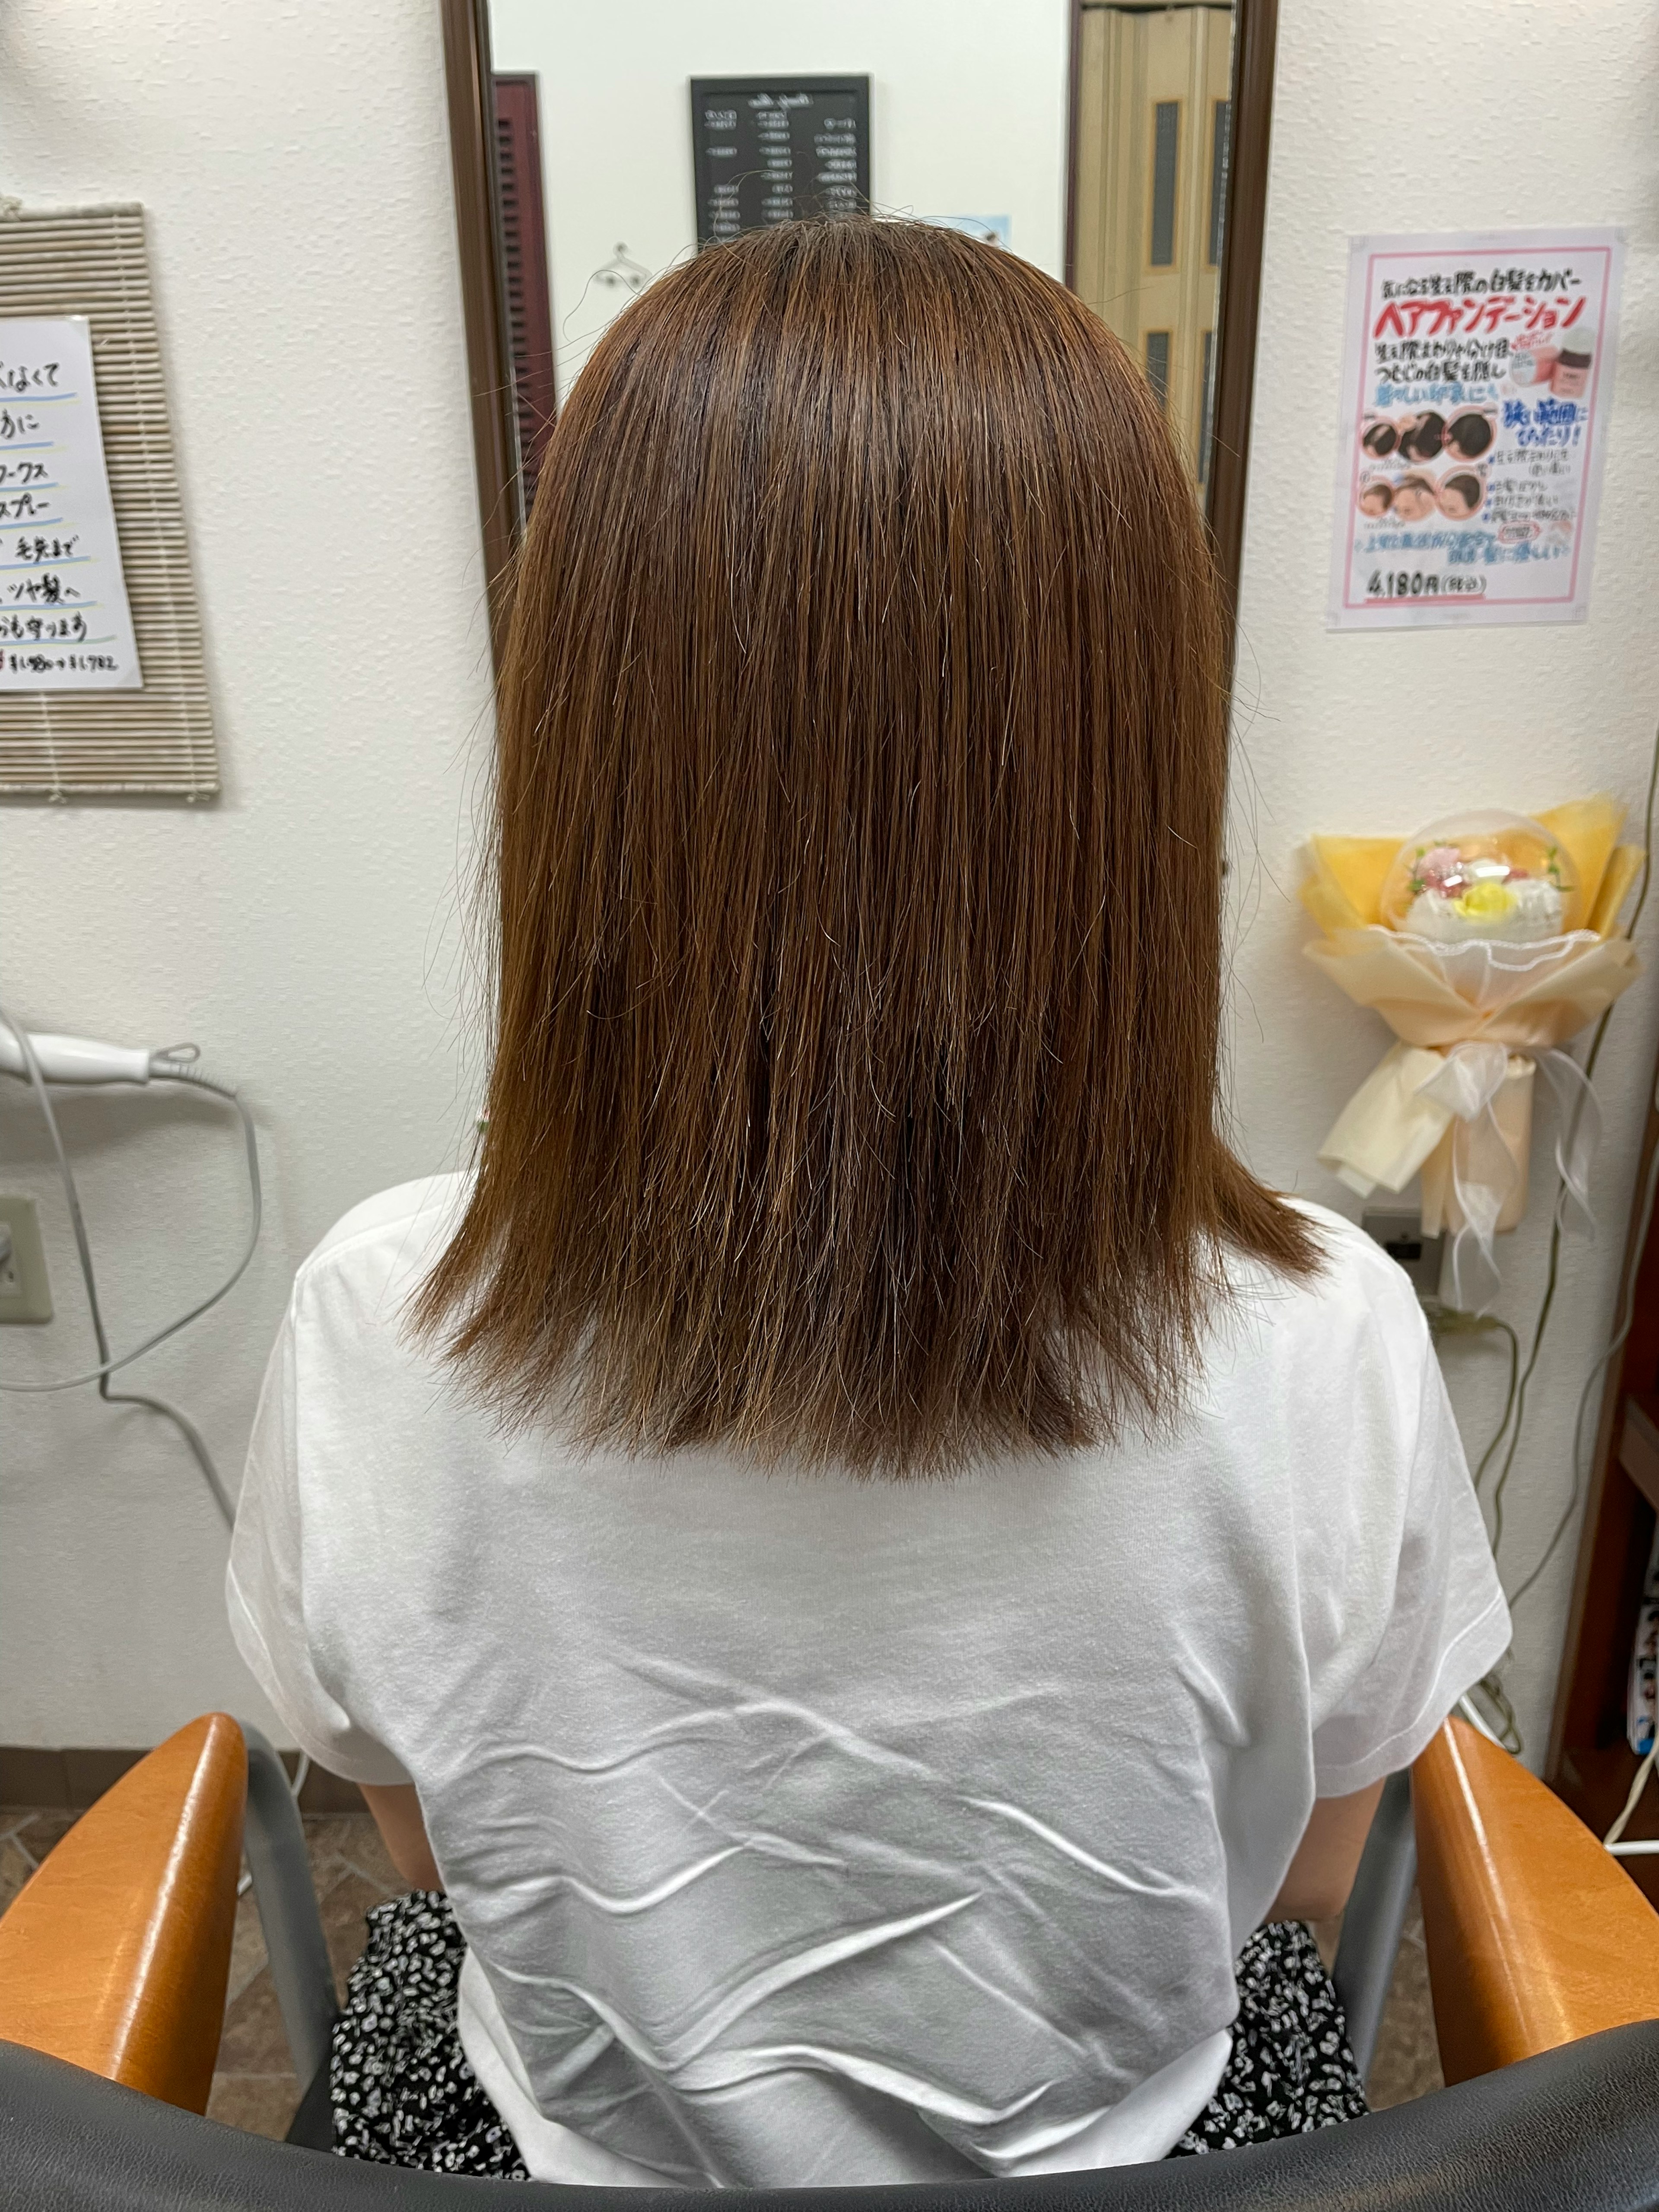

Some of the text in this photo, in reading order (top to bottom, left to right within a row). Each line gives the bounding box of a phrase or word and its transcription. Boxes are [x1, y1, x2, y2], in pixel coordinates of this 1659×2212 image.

[1373, 296, 1586, 338] ヘアファンデーション
